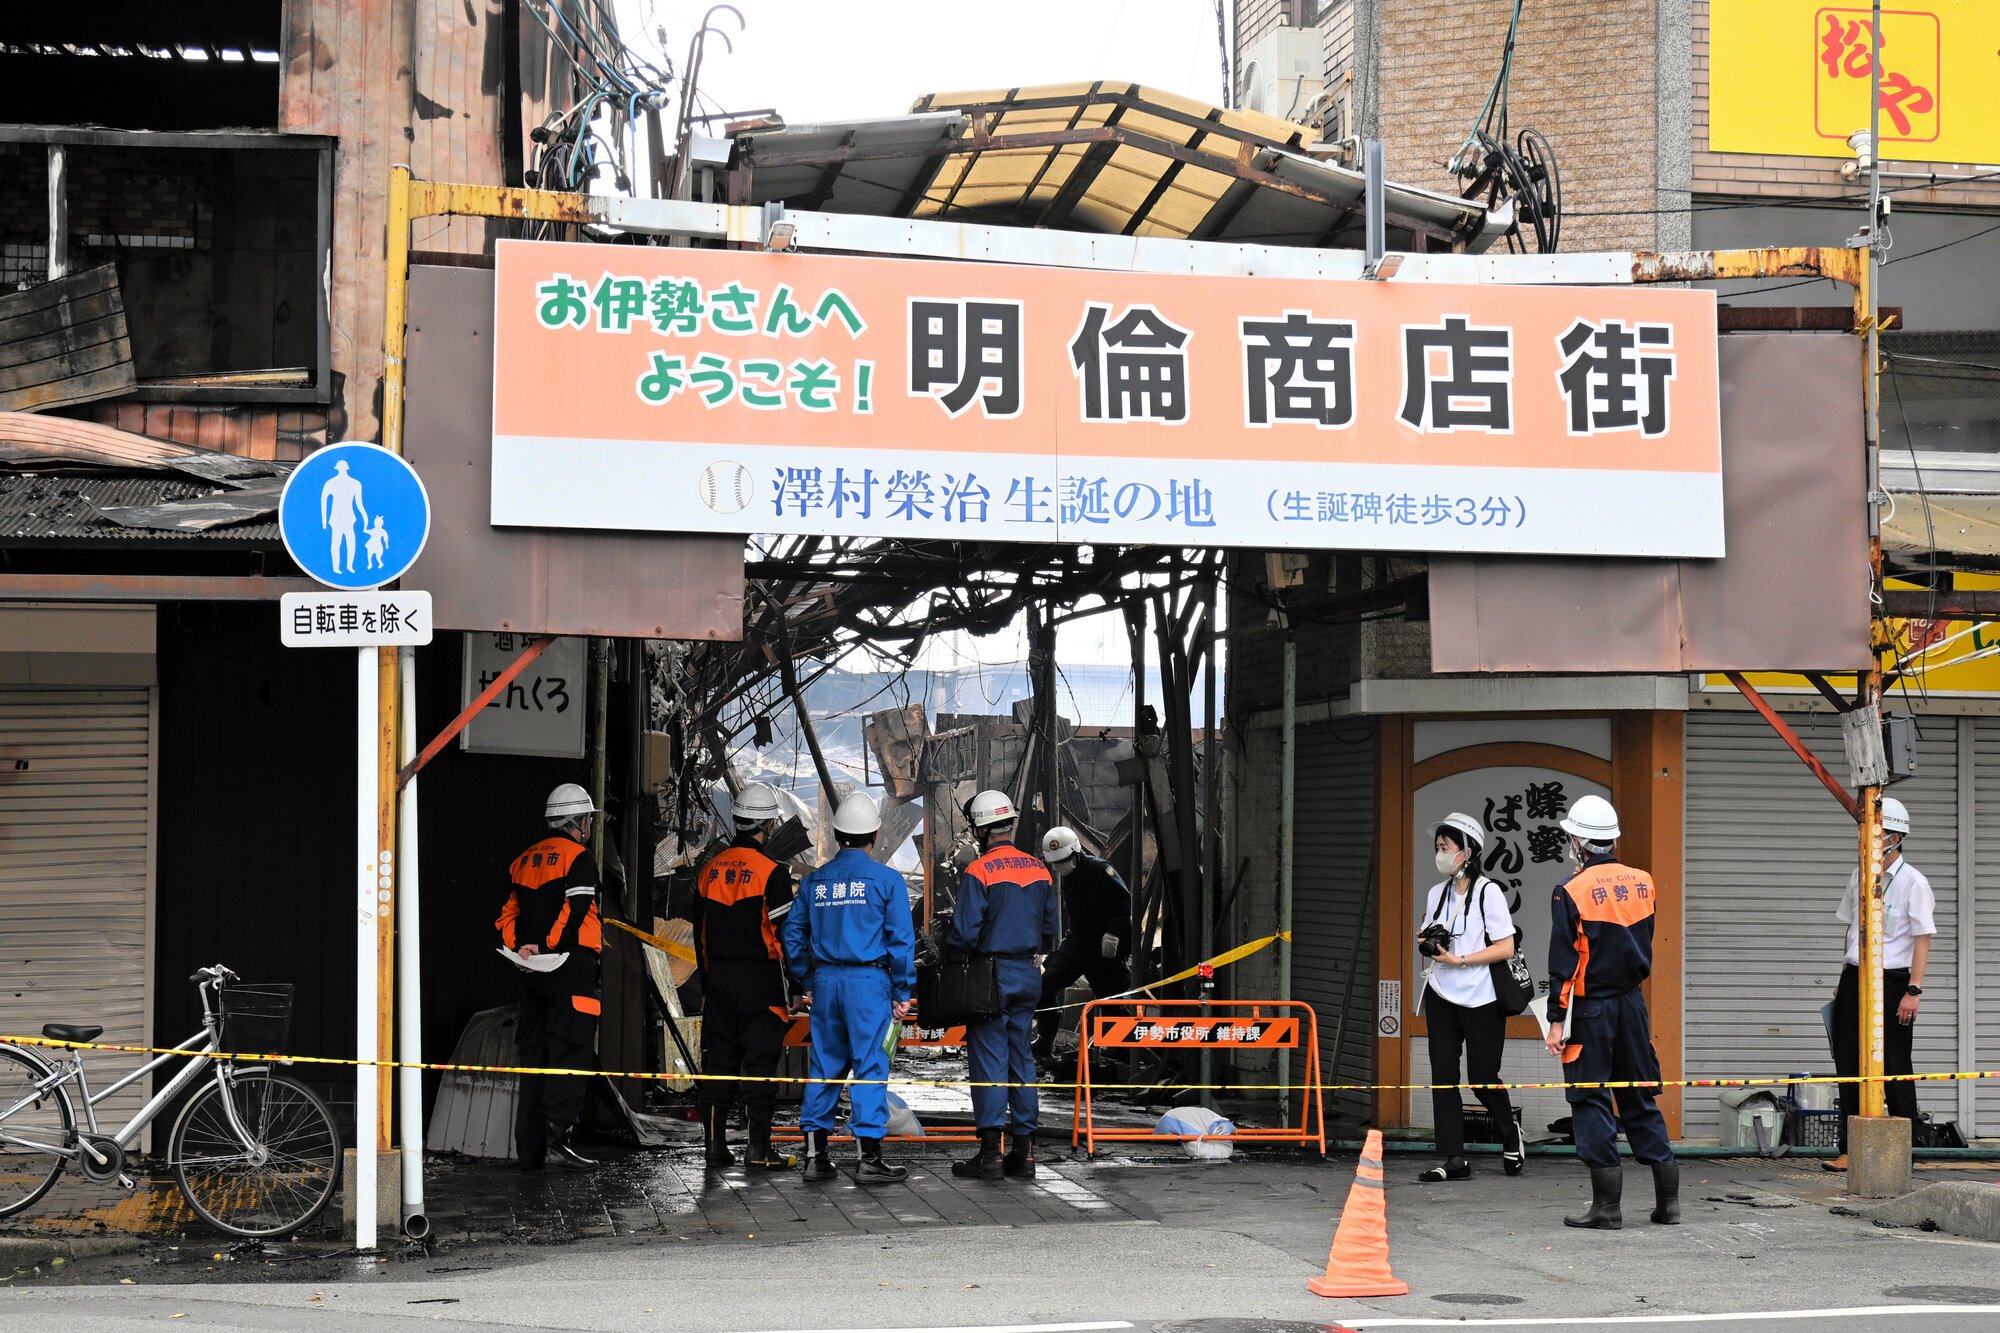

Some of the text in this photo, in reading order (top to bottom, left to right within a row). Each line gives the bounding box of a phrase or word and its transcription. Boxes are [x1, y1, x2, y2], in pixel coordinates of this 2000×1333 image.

[1821, 14, 1934, 136] 松や
[538, 275, 865, 336] お伊勢さんへ
[909, 299, 1674, 436] 明倫商店街
[293, 602, 418, 635] 自転車を除く
[1524, 781, 1568, 864] 蜂蜜
[814, 881, 866, 900] 衆議院
[1591, 882, 1649, 906] 伊勢市
[1596, 874, 1636, 885] Ise City
[1133, 1025, 1261, 1042] 伊勢市役所 維持課
